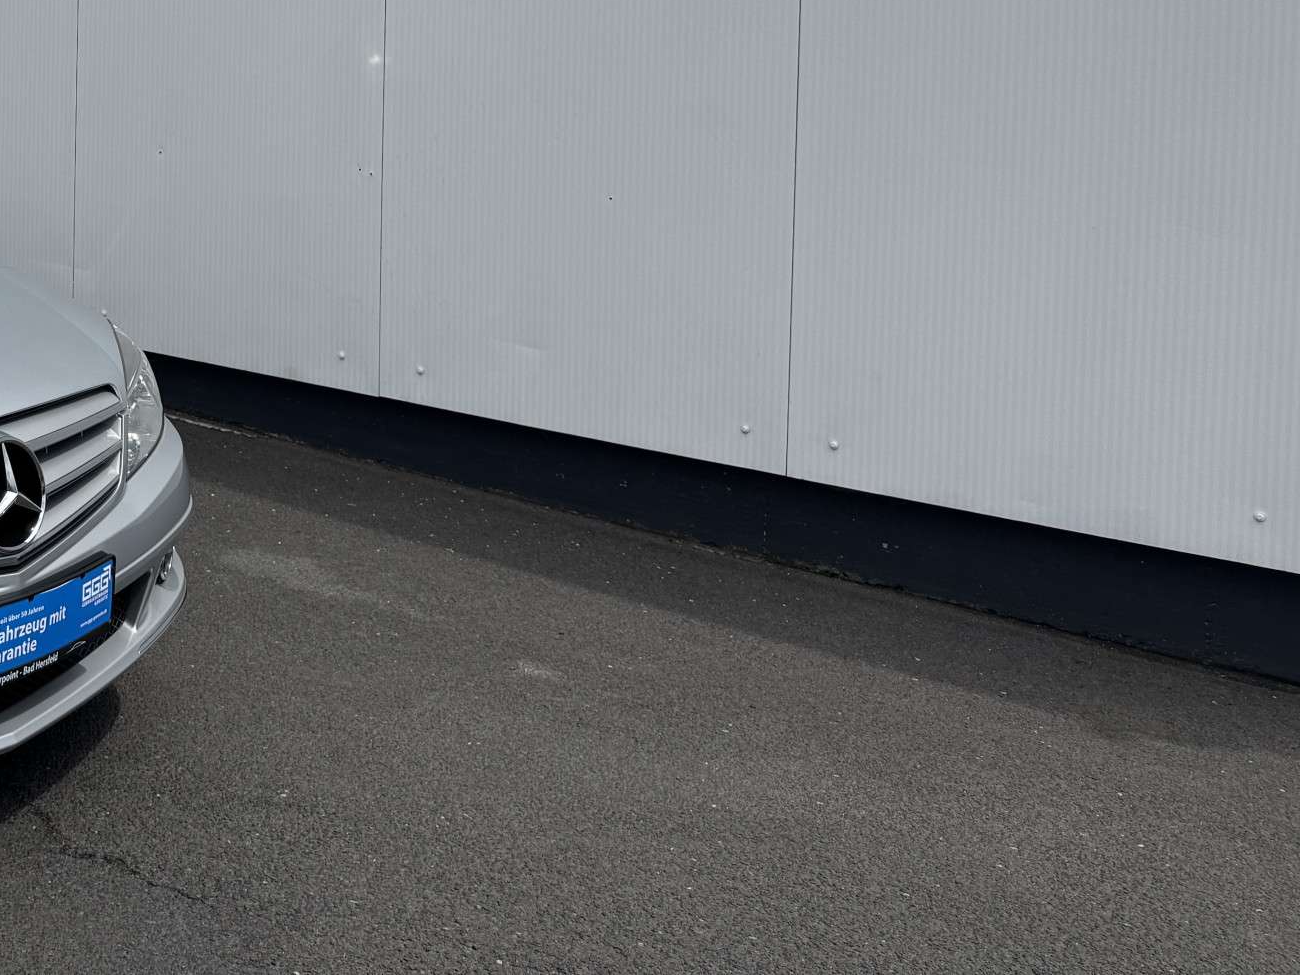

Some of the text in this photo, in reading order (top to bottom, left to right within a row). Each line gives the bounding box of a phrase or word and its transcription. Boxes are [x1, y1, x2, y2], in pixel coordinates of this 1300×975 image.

[82, 570, 109, 602] GGG
[8, 613, 21, 622] über
[28, 605, 45, 616] Jahren
[49, 605, 67, 626] mit
[22, 662, 35, 676] Bad
[35, 651, 59, 671] Hersfeld
